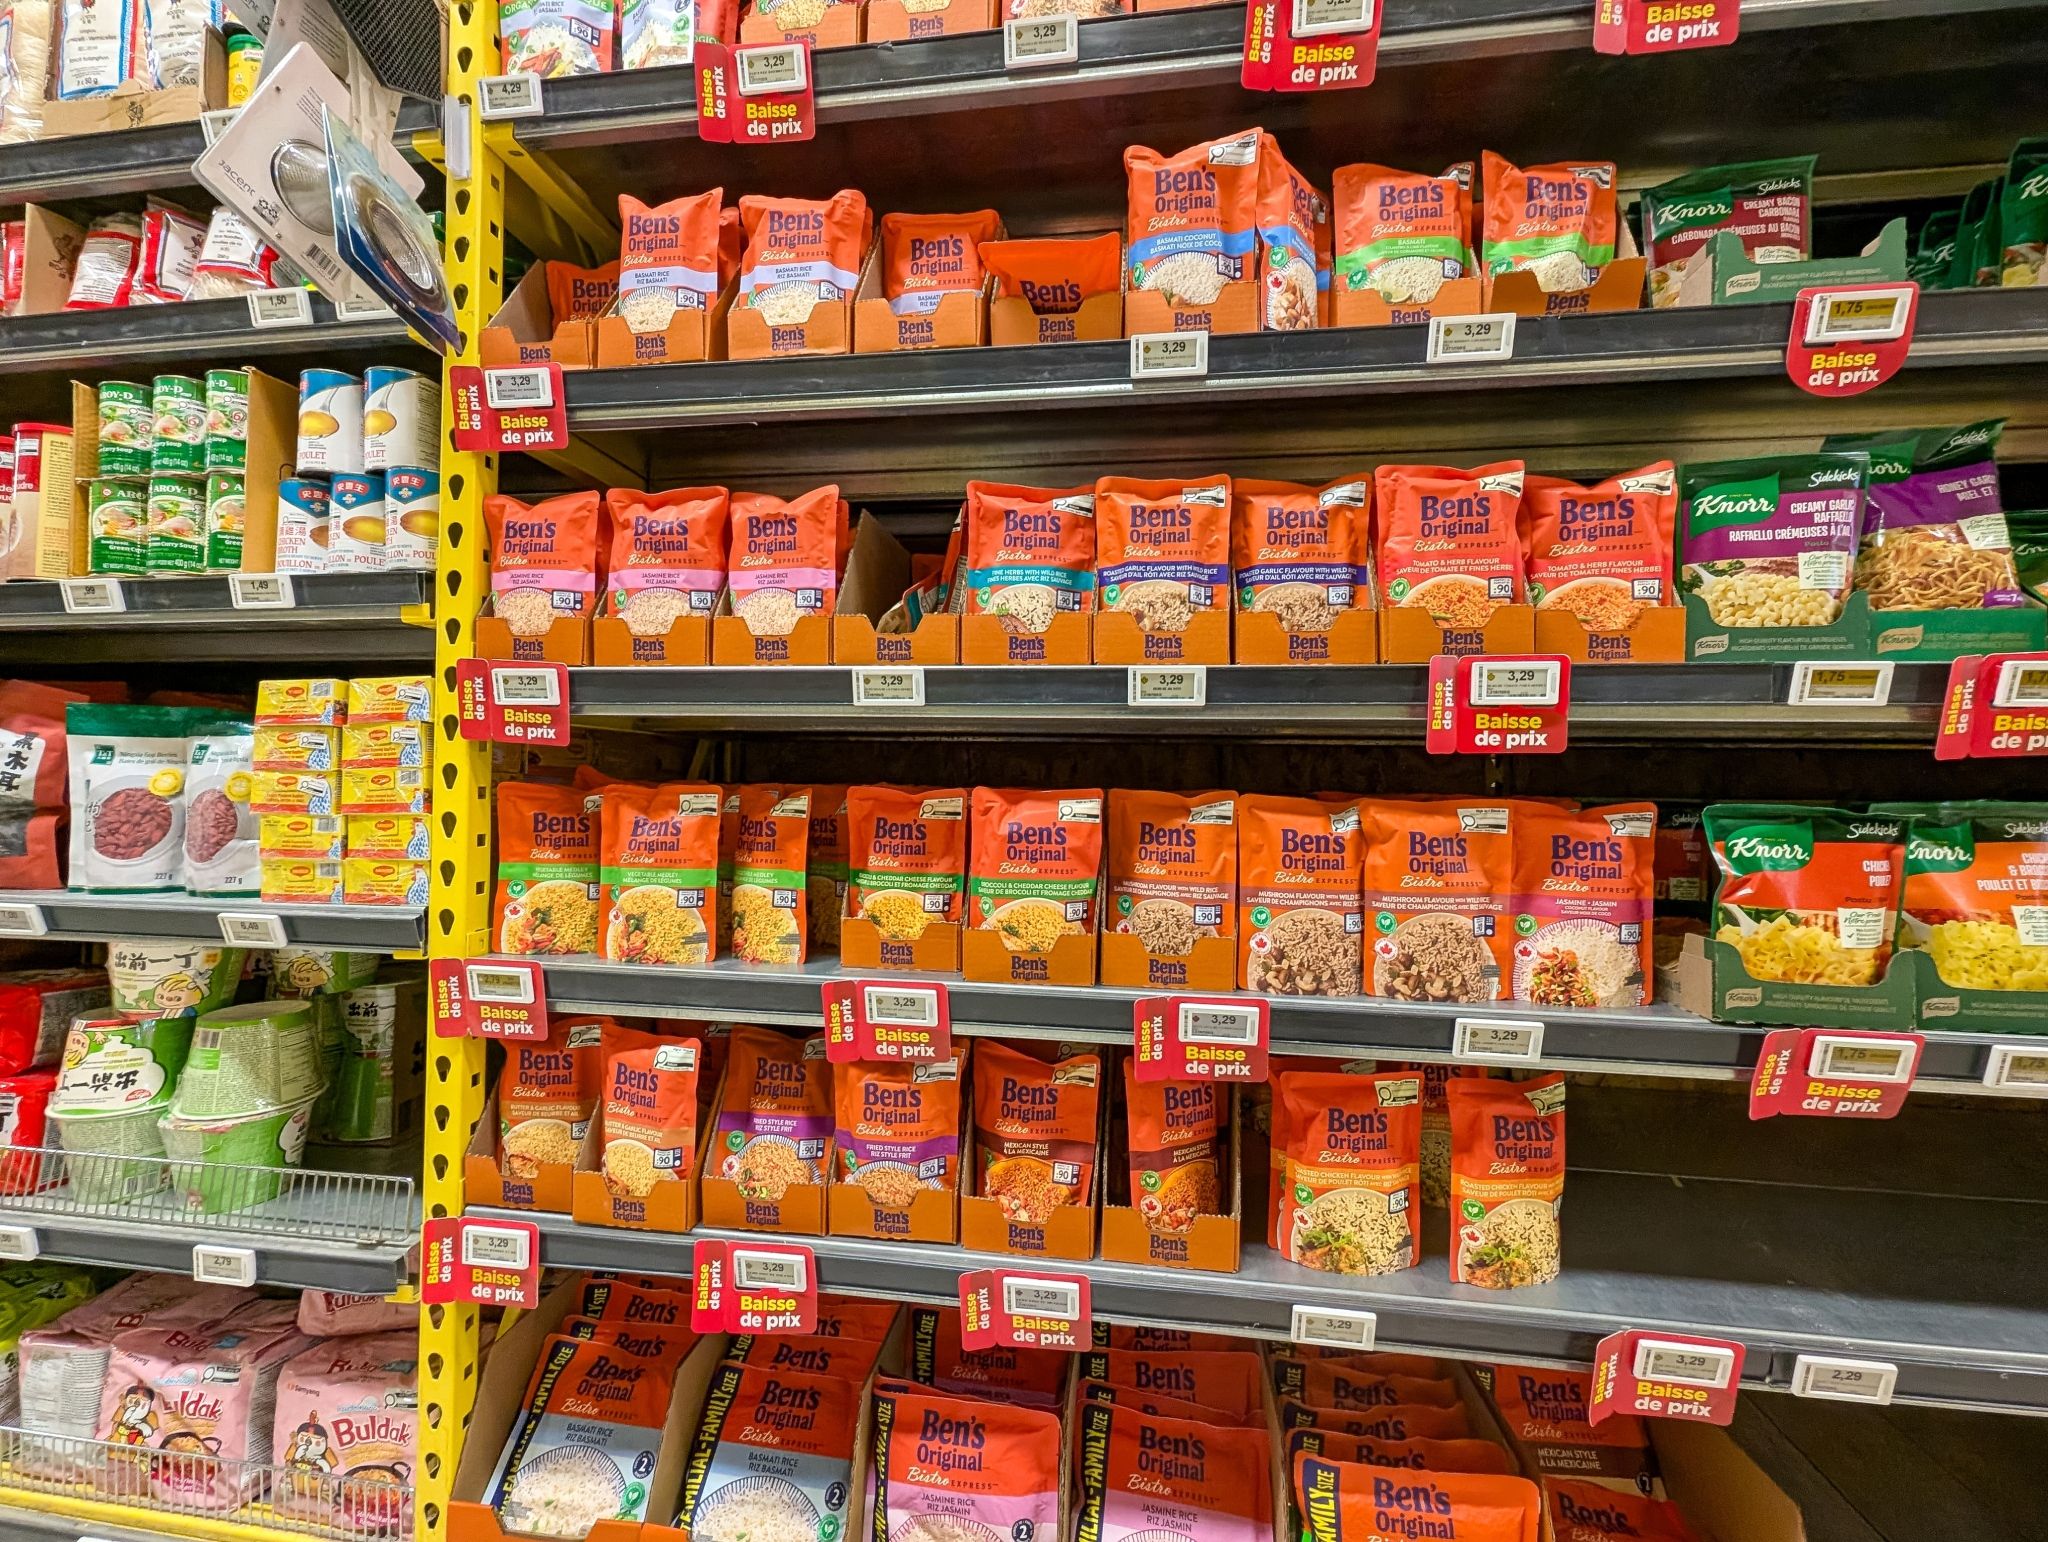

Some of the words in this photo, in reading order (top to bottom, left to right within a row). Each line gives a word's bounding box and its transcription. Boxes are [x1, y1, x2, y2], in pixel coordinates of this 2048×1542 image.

[1647, 4, 1715, 23] Baisse
[910, 17, 944, 33] Ben's
[1033, 25, 1056, 38] 3,29
[1646, 23, 1673, 43] de
[1677, 20, 1720, 45] prix
[764, 56, 785, 67] 3,29
[1293, 44, 1355, 64] Baisse
[714, 66, 724, 96] prix
[1292, 63, 1316, 83] de
[1320, 63, 1358, 84] prix
[502, 83, 521, 94] 4,29
[703, 69, 714, 118] Baisse
[714, 99, 725, 118] de
[746, 103, 797, 119] Baisse
[748, 120, 767, 135] de
[772, 119, 802, 138] prix
[1155, 166, 1215, 196] Ben's
[1379, 180, 1443, 207] Ben's
[1155, 193, 1215, 213] Original
[1744, 199, 1774, 210] CREAMY
[1379, 203, 1443, 222] Original
[1656, 202, 1731, 225] Knorr
[628, 214, 680, 237] Ben's
[1148, 215, 1188, 232] Bistro
[1372, 224, 1412, 238] Bistro
[628, 235, 678, 252] Original
[1157, 236, 1183, 245] BASMATI
[1184, 233, 1216, 241] COCONUT
[623, 253, 653, 267] Bistro
[1833, 300, 1863, 318] 1,75
[1464, 323, 1491, 337] 3,29
[1162, 341, 1186, 353] 3,29
[1811, 353, 1876, 370] Baisse
[511, 376, 530, 386] 3,29
[1808, 371, 1833, 386] de
[1838, 367, 1880, 387] prix
[500, 415, 548, 429] Baisse
[502, 429, 522, 444] de
[525, 429, 554, 446] prix
[1807, 468, 1859, 487] Sidekicks
[1421, 492, 1490, 522] Ben's
[1693, 493, 1770, 516] Knorr
[1791, 501, 1826, 514] CREAMY
[1130, 504, 1191, 528] Ben's
[1130, 529, 1191, 545] Original
[1420, 520, 1490, 538] Original
[1729, 529, 1773, 541] RAFFAELLO
[1775, 525, 1828, 539] CRÉMEUSES
[1123, 546, 1161, 558] Bistro
[1413, 540, 1455, 554] Bistro
[354, 555, 385, 566] POULE
[518, 676, 538, 686] 3,29
[881, 675, 903, 686] 3,29
[1159, 673, 1183, 685] 3,29
[1507, 670, 1535, 682] 3,29
[1816, 671, 1845, 684] 1,75
[1475, 714, 1542, 729] Baisse
[1474, 731, 1502, 746] de
[1505, 731, 1547, 748] prix
[1007, 822, 1066, 846] Ben's
[1846, 823, 1898, 839] Sidekicks
[1007, 845, 1066, 863] Original
[1551, 835, 1622, 862] Ben's
[1729, 837, 1810, 860] Knorr
[999, 862, 1037, 874] Bistro
[1551, 860, 1622, 881] Original
[1541, 878, 1589, 893] Bistro
[2016, 879, 2028, 890] ET
[115, 950, 199, 971] 出前一丁
[893, 997, 915, 1007] 3,29
[875, 1028, 930, 1043] Baisse
[1491, 1030, 1518, 1041] 3,29
[876, 1043, 899, 1057] de
[902, 1043, 936, 1059] prix
[1836, 1048, 1867, 1060] 1,75
[615, 1062, 658, 1093] Ben's
[614, 1085, 656, 1109] Original
[864, 1083, 921, 1108] Ben's
[1806, 1082, 1882, 1099] Baisse
[1801, 1097, 1831, 1111] de
[1834, 1099, 1883, 1114] prix
[863, 1106, 921, 1125] Original
[856, 1123, 893, 1137] Bistro
[489, 1237, 509, 1248] 3,29
[762, 1262, 784, 1272] 3,29
[740, 1295, 796, 1311] Baisse
[1033, 1289, 1058, 1300] 3,29
[740, 1313, 763, 1327] de
[766, 1313, 801, 1330] prix
[1012, 1316, 1070, 1331] Baisse
[1325, 1319, 1352, 1330] 3,29
[1013, 1329, 1036, 1343] de
[1041, 1332, 1076, 1346] prix
[1675, 1354, 1706, 1367] 3,29
[1831, 1370, 1862, 1382] 2,29
[1637, 1381, 1708, 1402] Baisse
[1634, 1396, 1663, 1412] de
[1666, 1400, 1712, 1418] prix
[331, 1415, 411, 1447] Buldak
[920, 1409, 985, 1449] Ben's
[917, 1442, 983, 1472] Original
[907, 1467, 949, 1486] Bistro
[921, 1493, 955, 1504] JASMINE
[1374, 1477, 1451, 1515] Ben's
[927, 1503, 939, 1511] RIZ
[941, 1506, 970, 1515] JASMIN
[1376, 1511, 1455, 1540] Original
